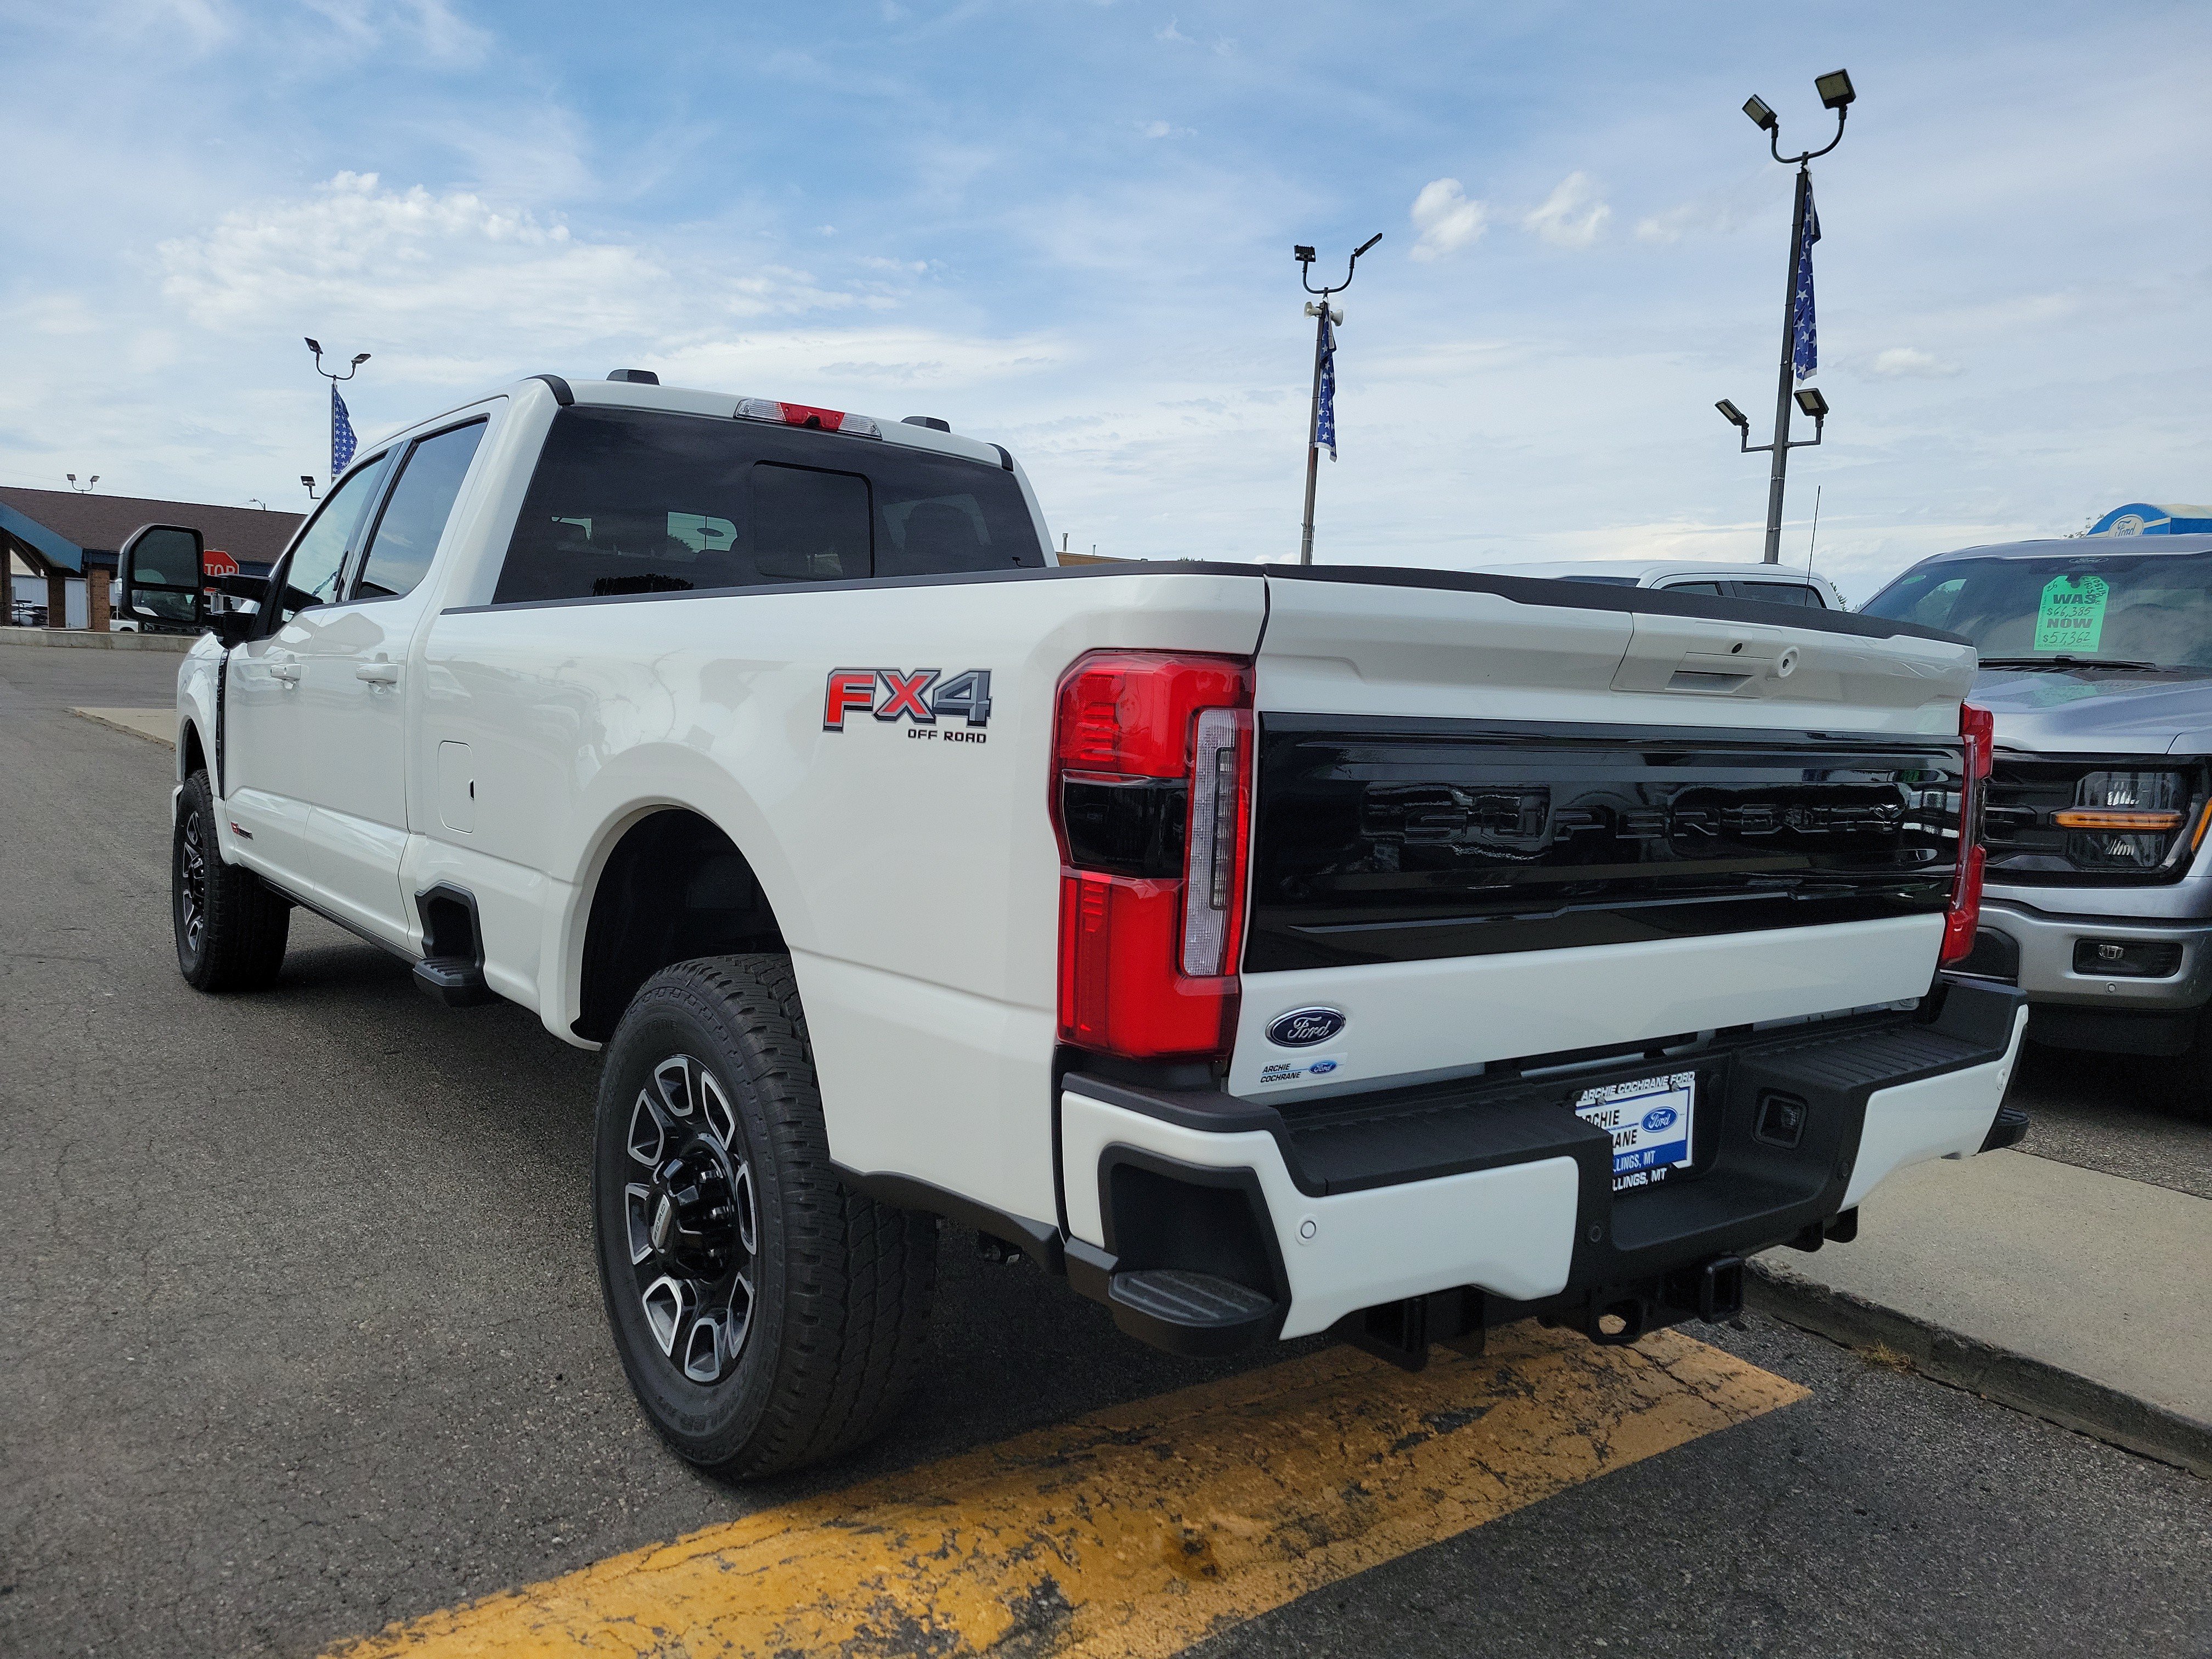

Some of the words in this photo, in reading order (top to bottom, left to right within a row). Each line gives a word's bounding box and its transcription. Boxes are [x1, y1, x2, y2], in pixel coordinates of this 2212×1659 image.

[205, 563, 235, 575] TOP
[2053, 594, 2097, 604] WAS
[2047, 606, 2095, 618] $66,385
[2047, 618, 2093, 629] NOW
[2042, 631, 2091, 645] $57,362
[822, 667, 993, 733] FX4
[907, 728, 938, 740] OFF
[943, 730, 987, 744] ROAD
[1287, 1015, 1331, 1040] Ford
[1262, 1063, 1291, 1074] ARCHIE
[1260, 1071, 1302, 1083] COCHRANE
[1581, 1085, 1617, 1101] ARCHIE
[1617, 1075, 1670, 1094] COCHRANE
[1669, 1071, 1695, 1085] FORD
[1585, 1109, 1620, 1127] CHIE
[1648, 1110, 1671, 1129] Ford
[1613, 1153, 1641, 1172] LINGS,
[1643, 1150, 1656, 1166] MT
[1612, 1172, 1649, 1192] LLINGS,
[1650, 1167, 1667, 1183] MT
